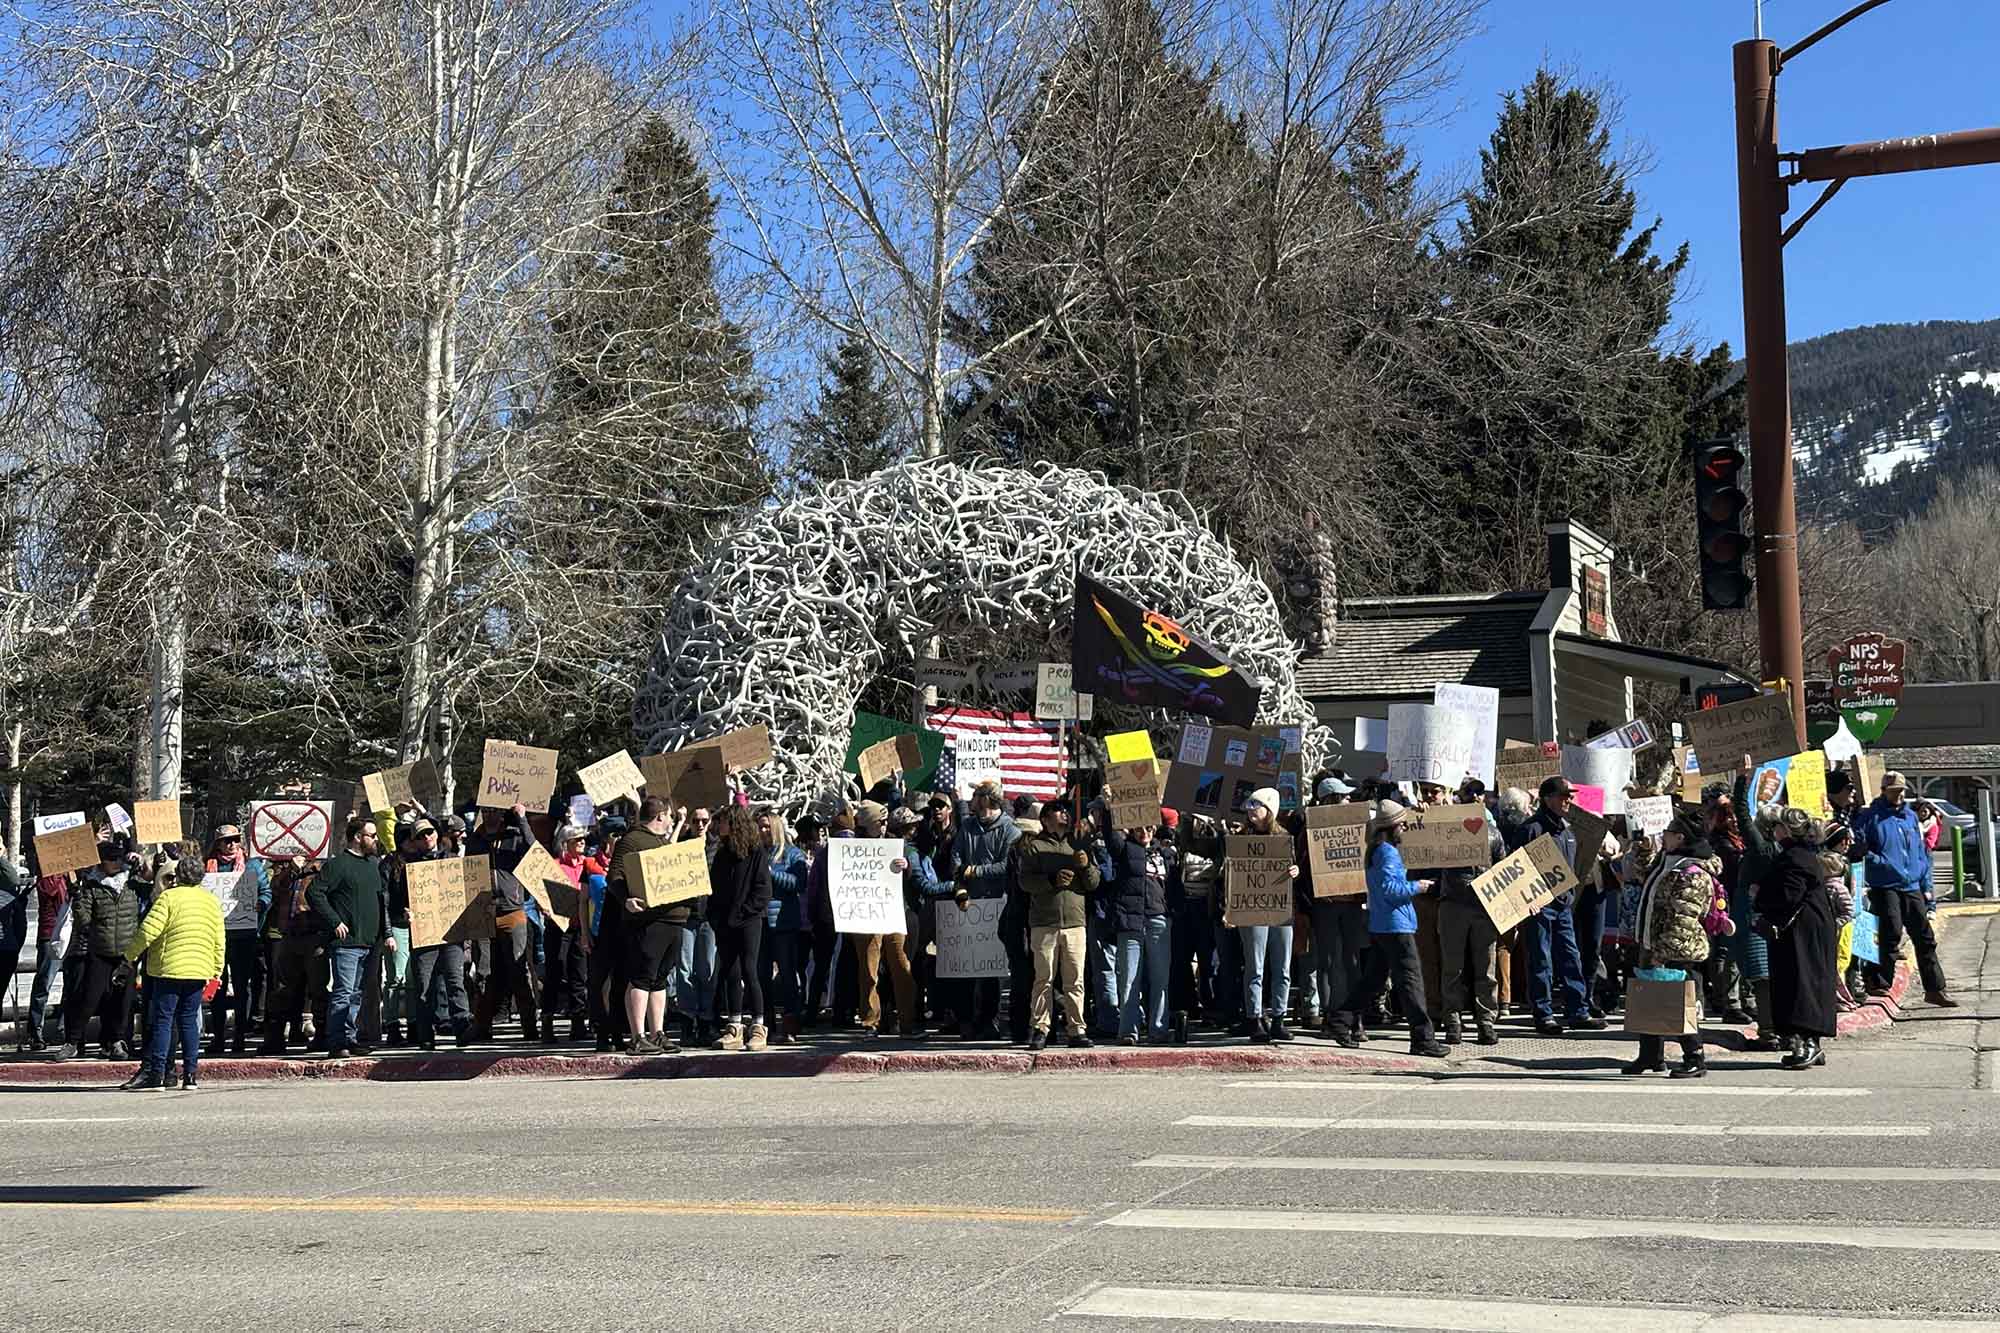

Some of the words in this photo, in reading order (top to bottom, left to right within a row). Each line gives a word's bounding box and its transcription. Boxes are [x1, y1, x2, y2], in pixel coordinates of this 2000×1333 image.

[1850, 643, 1879, 659] NPS
[923, 667, 967, 679] JACKSON
[1840, 661, 1860, 672] Paid
[1864, 660, 1879, 670] for
[1883, 660, 1896, 672] by
[1838, 673, 1899, 687] Grandparents
[1840, 694, 1896, 708] Grandchildren
[957, 738, 983, 752] HANDS
[984, 739, 997, 752] OFF
[957, 757, 975, 770] THESE
[979, 757, 999, 769] TETONS
[1392, 759, 1442, 780] FIRED
[1108, 766, 1121, 781] I
[486, 776, 520, 796] Public
[140, 806, 177, 818] DUMP
[139, 823, 178, 834] TRUMP
[1312, 826, 1364, 842] BULLSHIT
[1247, 842, 1266, 856] NO
[1322, 836, 1359, 849] LEVELS
[841, 844, 888, 859] PUBLIC
[841, 860, 885, 872] LANDS
[1328, 859, 1361, 871] TODAY!
[841, 872, 877, 881] MAKE
[1247, 873, 1266, 889] NO
[1480, 858, 1525, 903] HANDS
[1520, 865, 1566, 904] LANDS
[836, 886, 894, 899] AMERICA
[838, 902, 889, 921] GREAT
